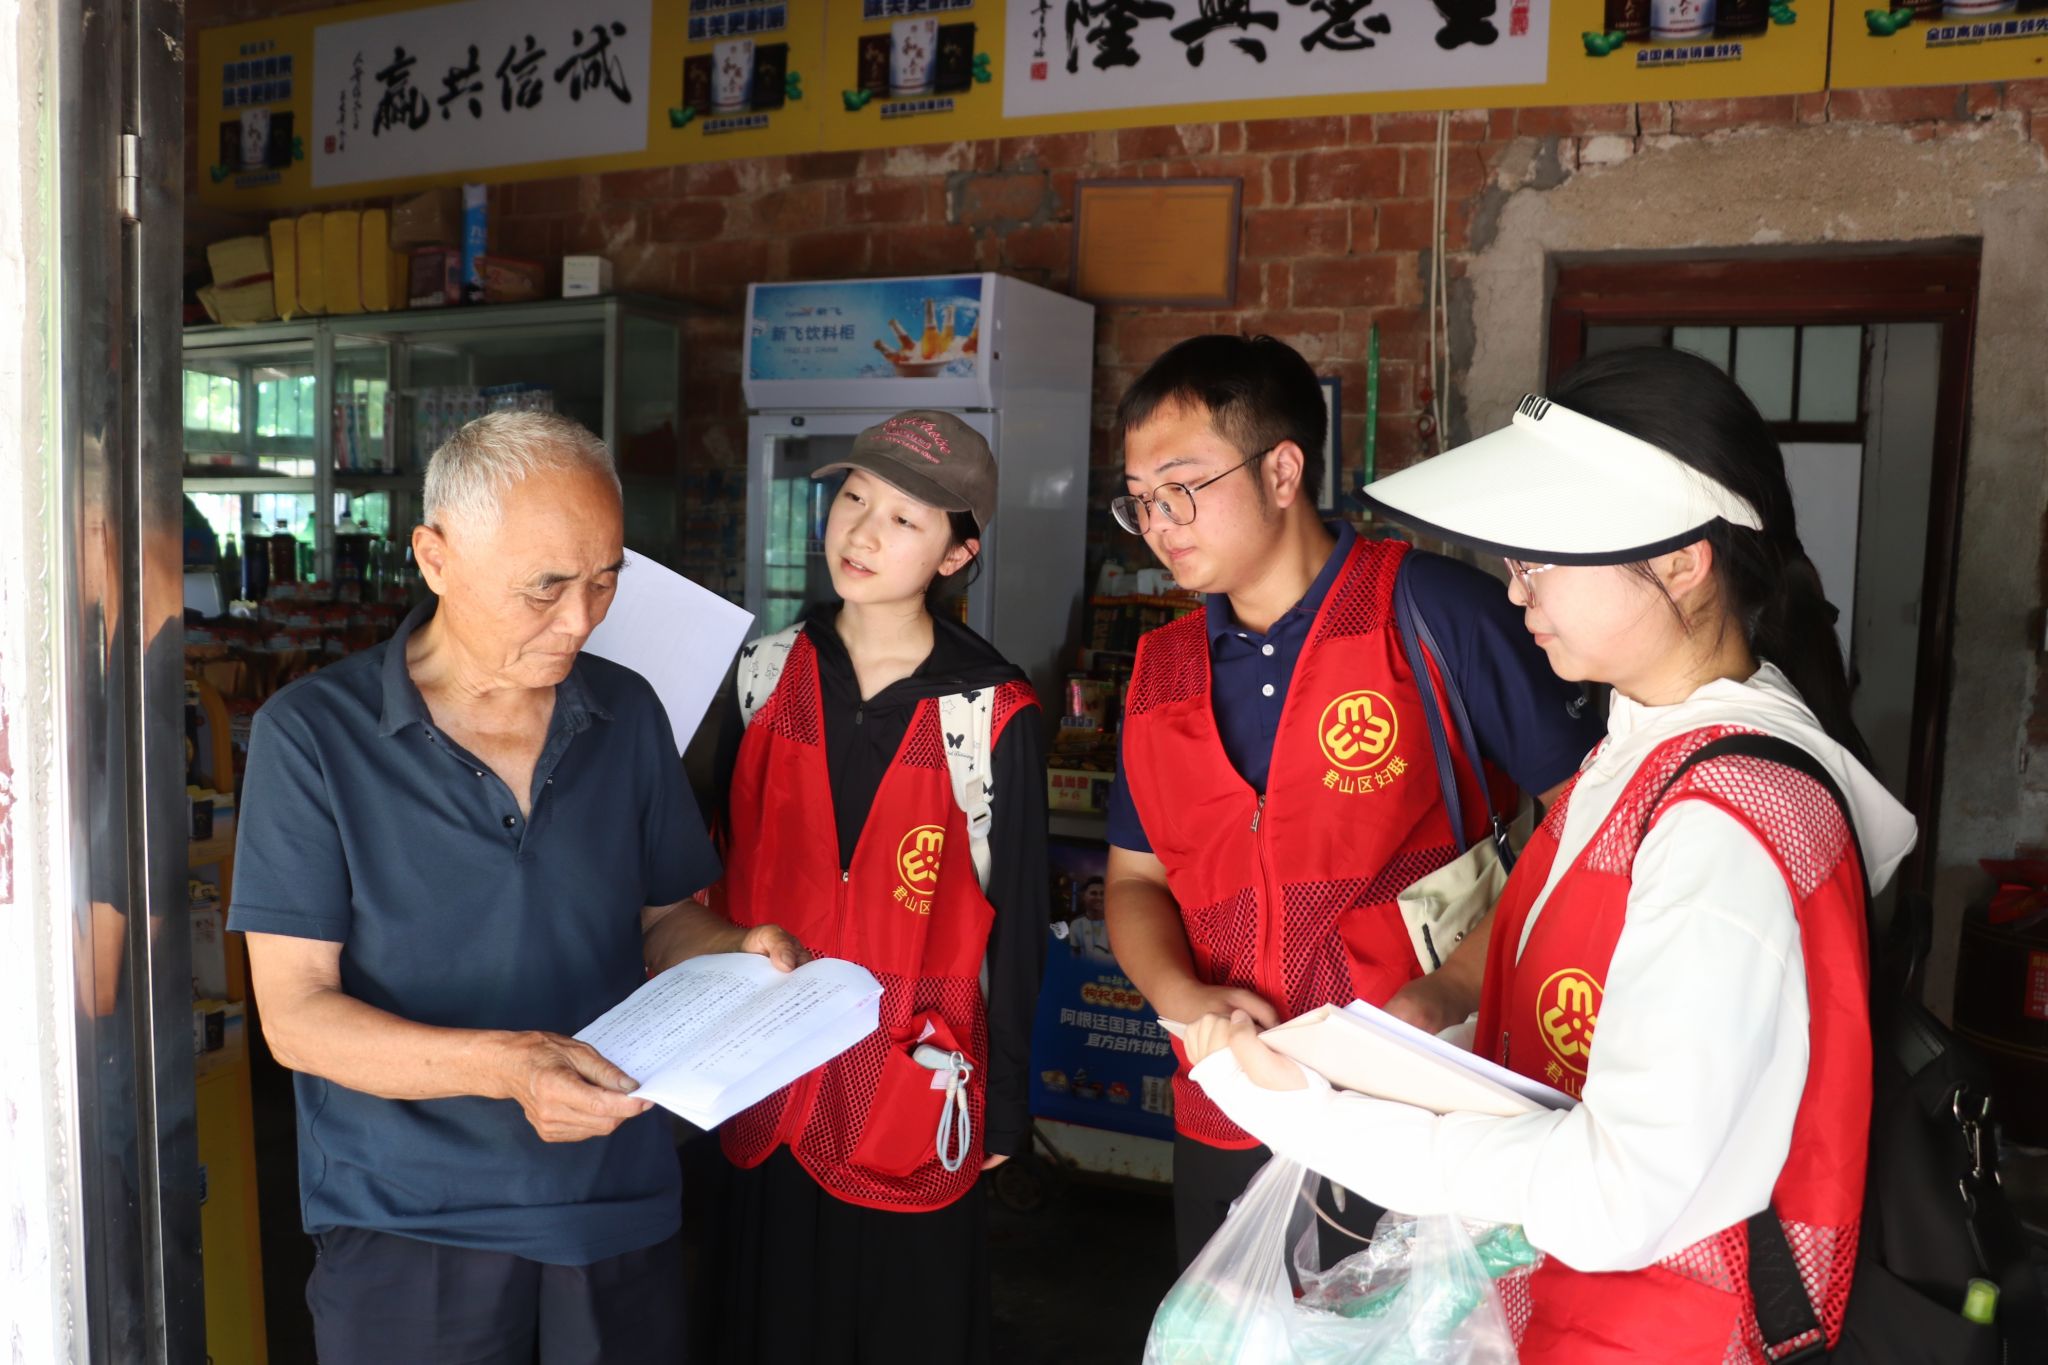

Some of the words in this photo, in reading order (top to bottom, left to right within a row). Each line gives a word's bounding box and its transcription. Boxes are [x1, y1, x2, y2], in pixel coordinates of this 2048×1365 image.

[1637, 44, 1742, 61] 全国高端销量领先
[772, 324, 855, 341] 新飞饮料柜
[1322, 755, 1408, 794] 君山区妇联
[892, 885, 931, 915] 君山区
[1085, 1033, 1170, 1056] 官方合作伙伴
